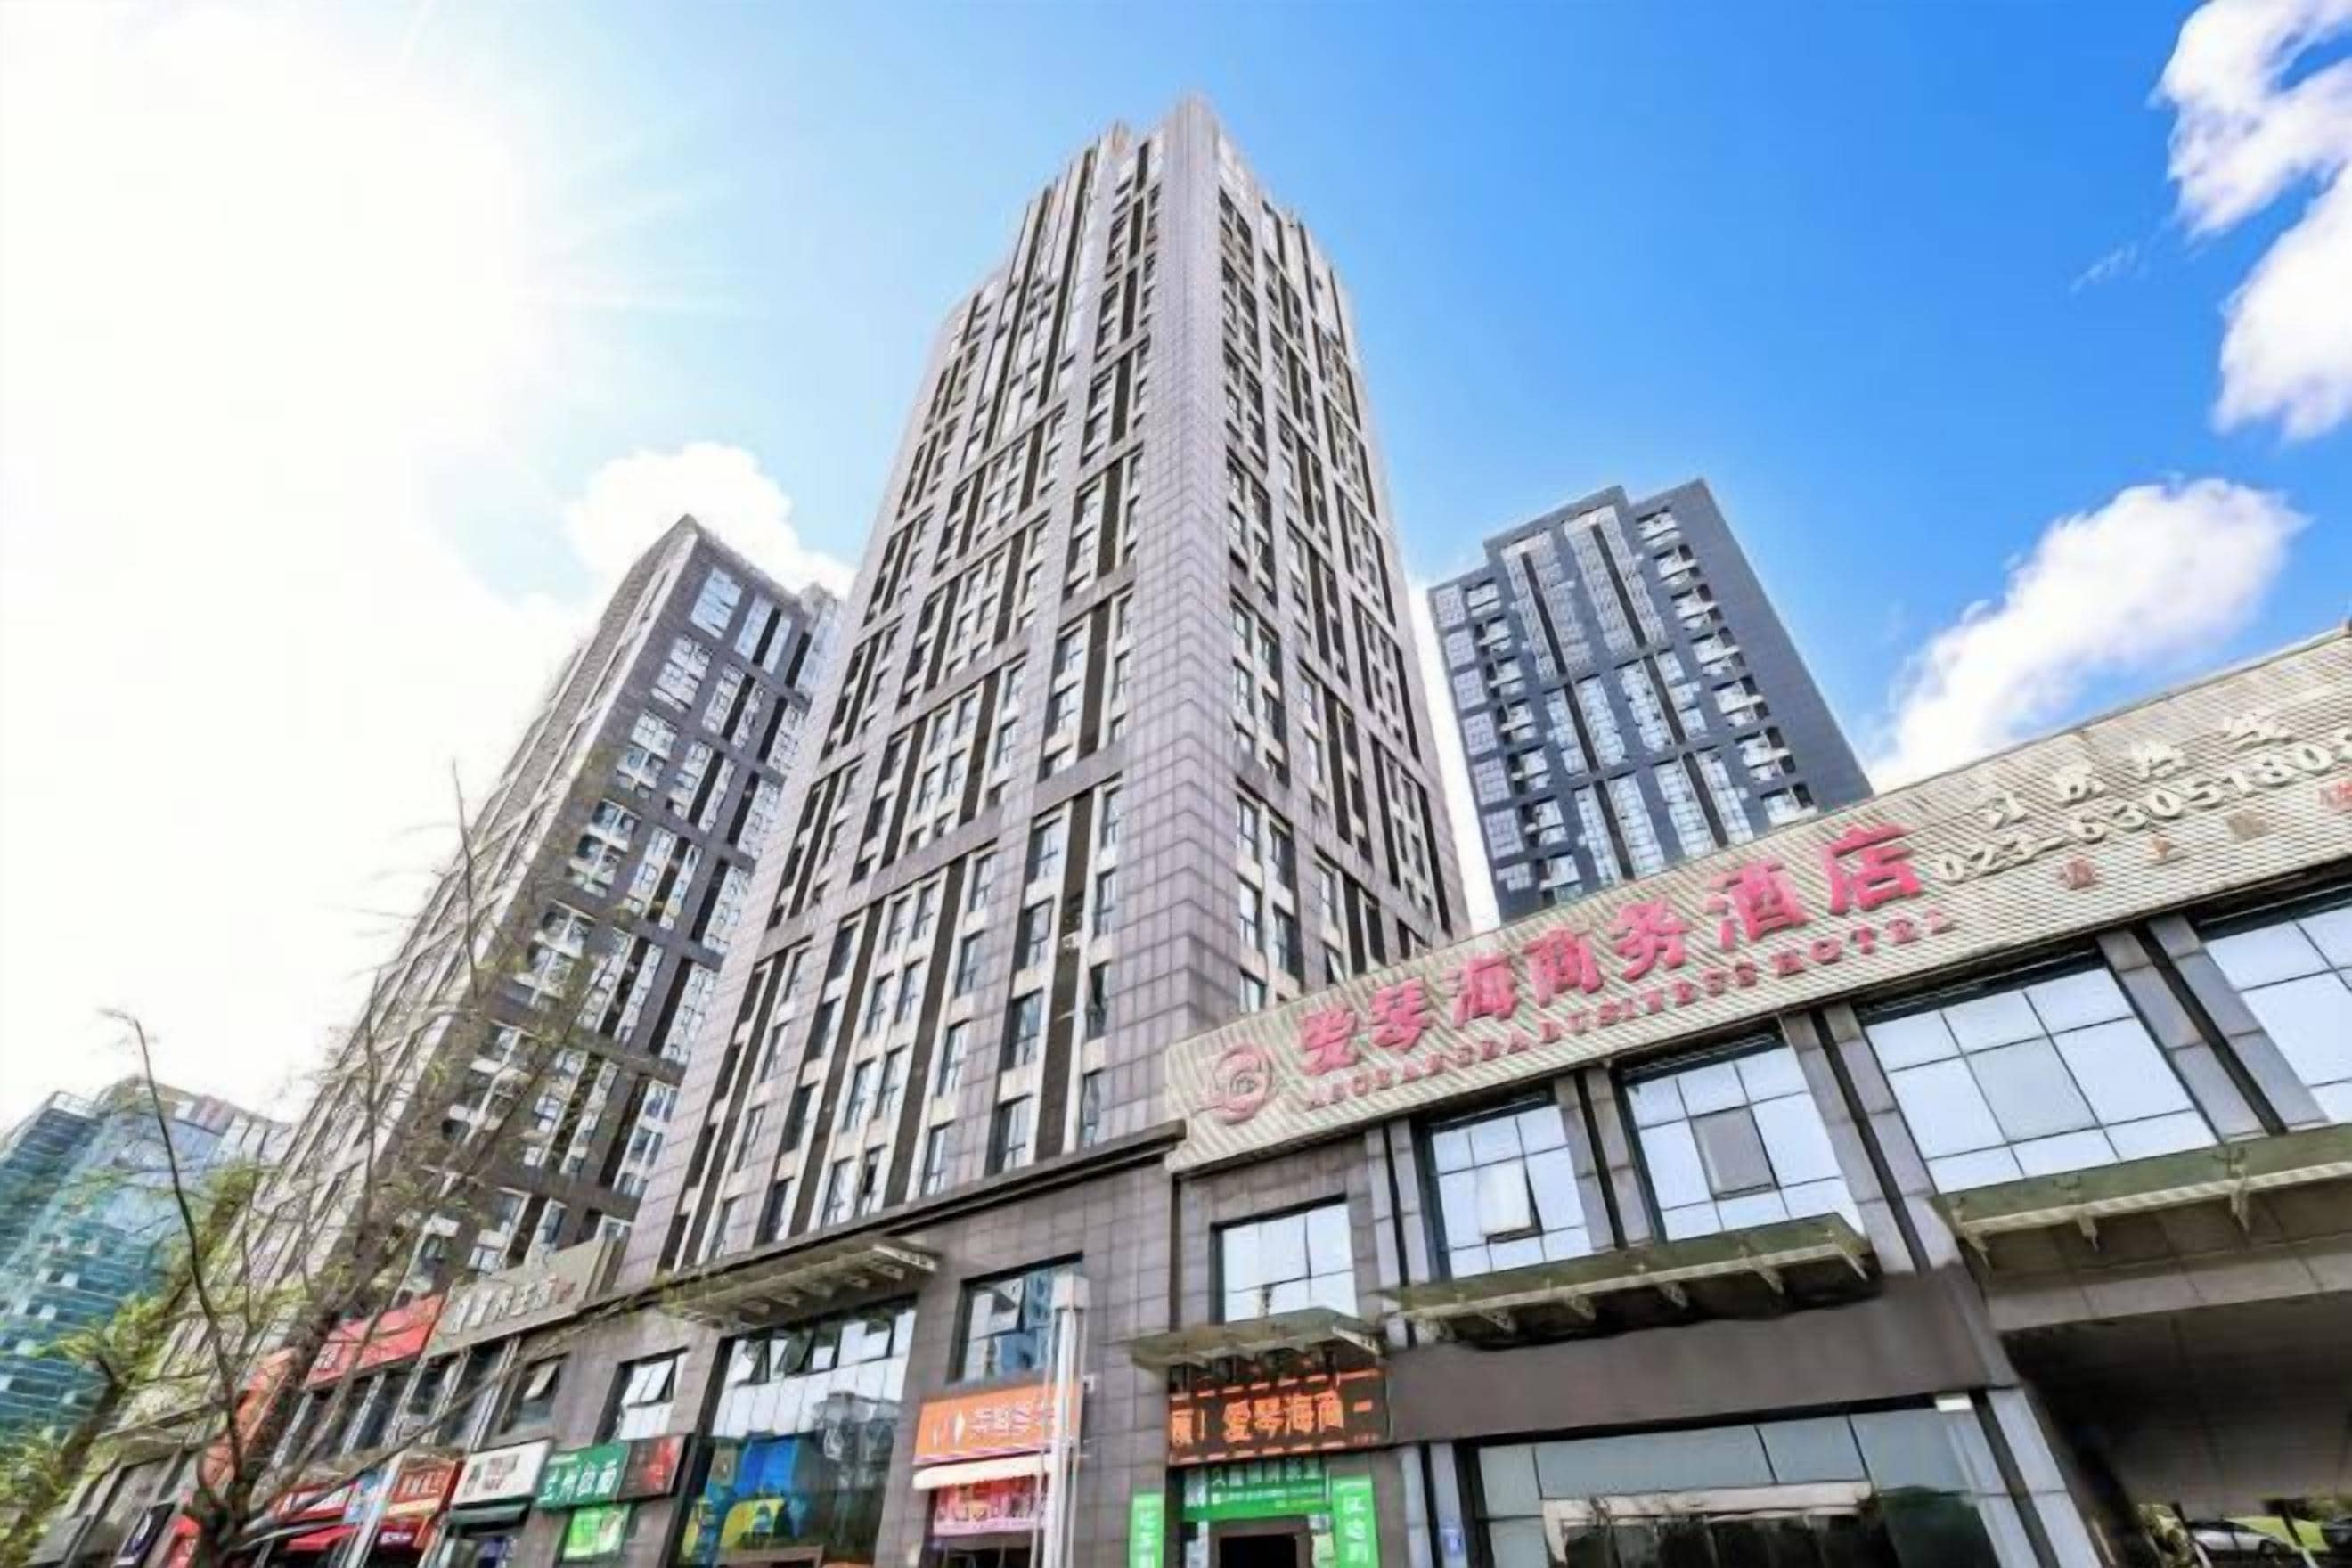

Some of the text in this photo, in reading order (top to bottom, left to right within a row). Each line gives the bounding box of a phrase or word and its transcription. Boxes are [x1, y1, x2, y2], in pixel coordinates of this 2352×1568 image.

[1298, 821, 1923, 1075] 爱琴海商务酒店
